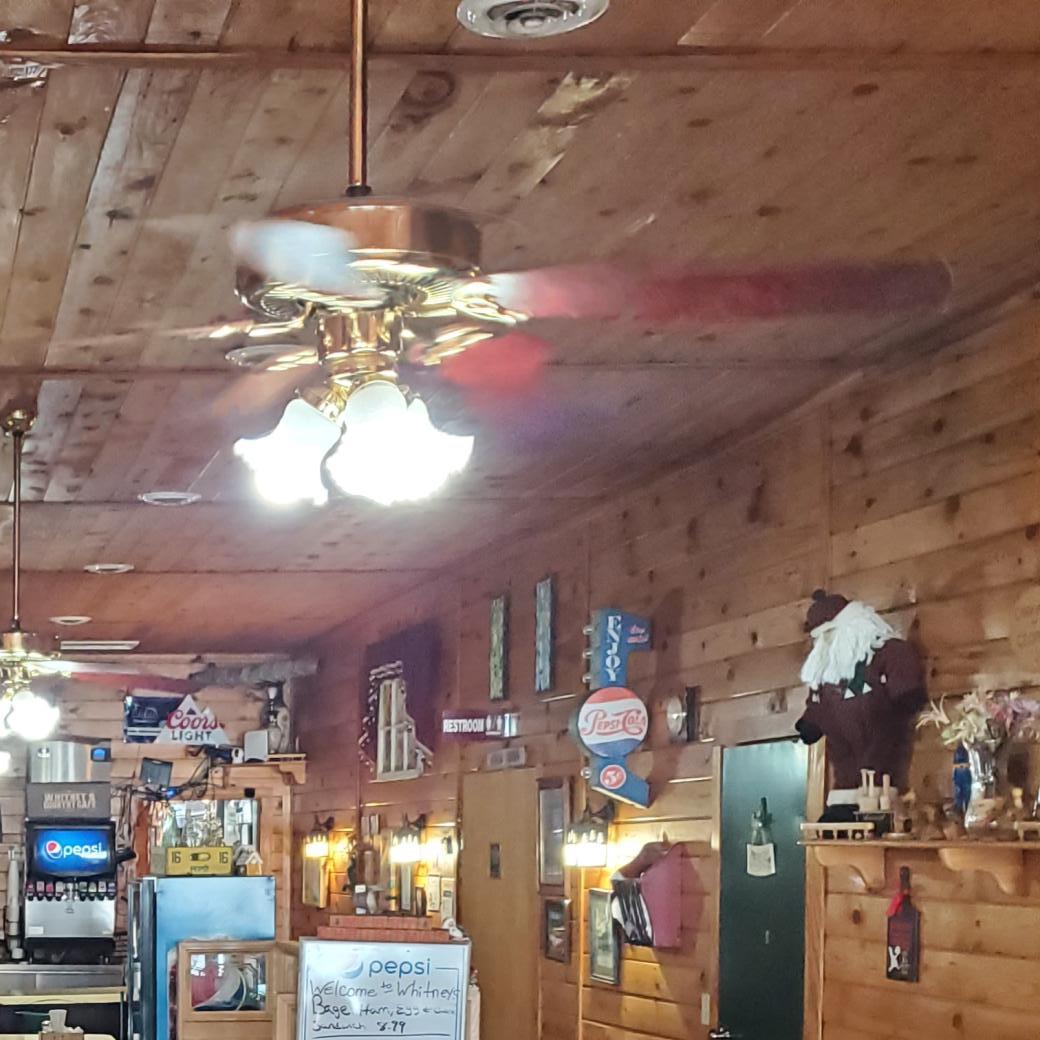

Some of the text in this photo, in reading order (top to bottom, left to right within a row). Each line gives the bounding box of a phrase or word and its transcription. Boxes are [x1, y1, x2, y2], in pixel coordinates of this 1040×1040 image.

[605, 615, 622, 682] ENJOY
[166, 709, 219, 730] Coors
[443, 718, 485, 733] RESTROOM
[171, 731, 212, 741] LIGHT
[63, 842, 102, 858] pepsi
[369, 958, 431, 978] pepsi
